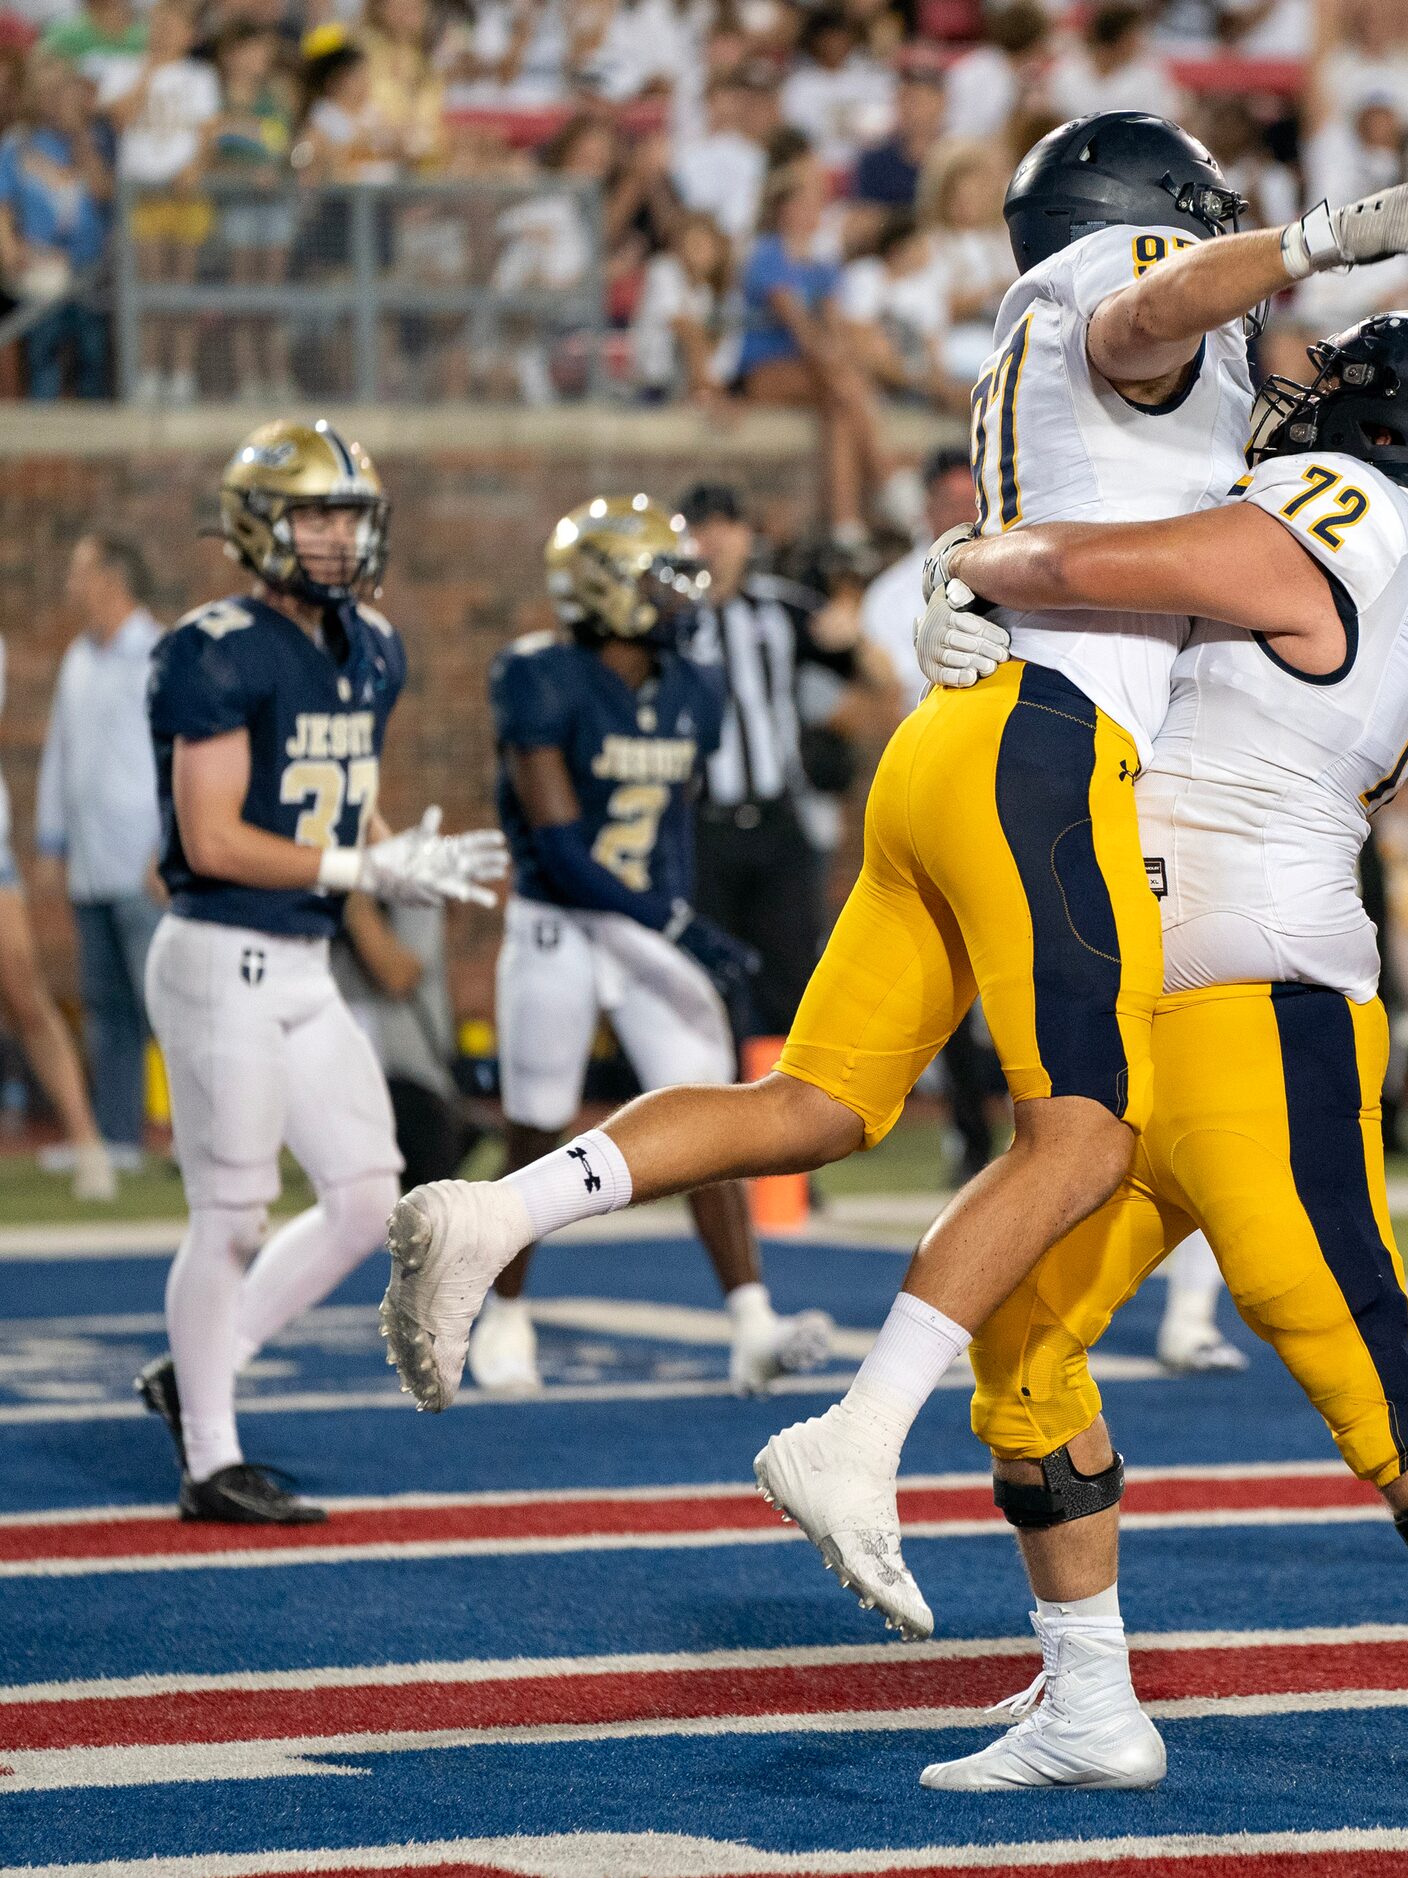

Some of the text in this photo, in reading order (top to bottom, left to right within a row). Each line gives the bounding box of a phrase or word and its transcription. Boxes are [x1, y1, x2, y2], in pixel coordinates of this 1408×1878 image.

[1132, 235, 1196, 280] 9
[1279, 463, 1370, 553] 72
[591, 783, 672, 893] 2
